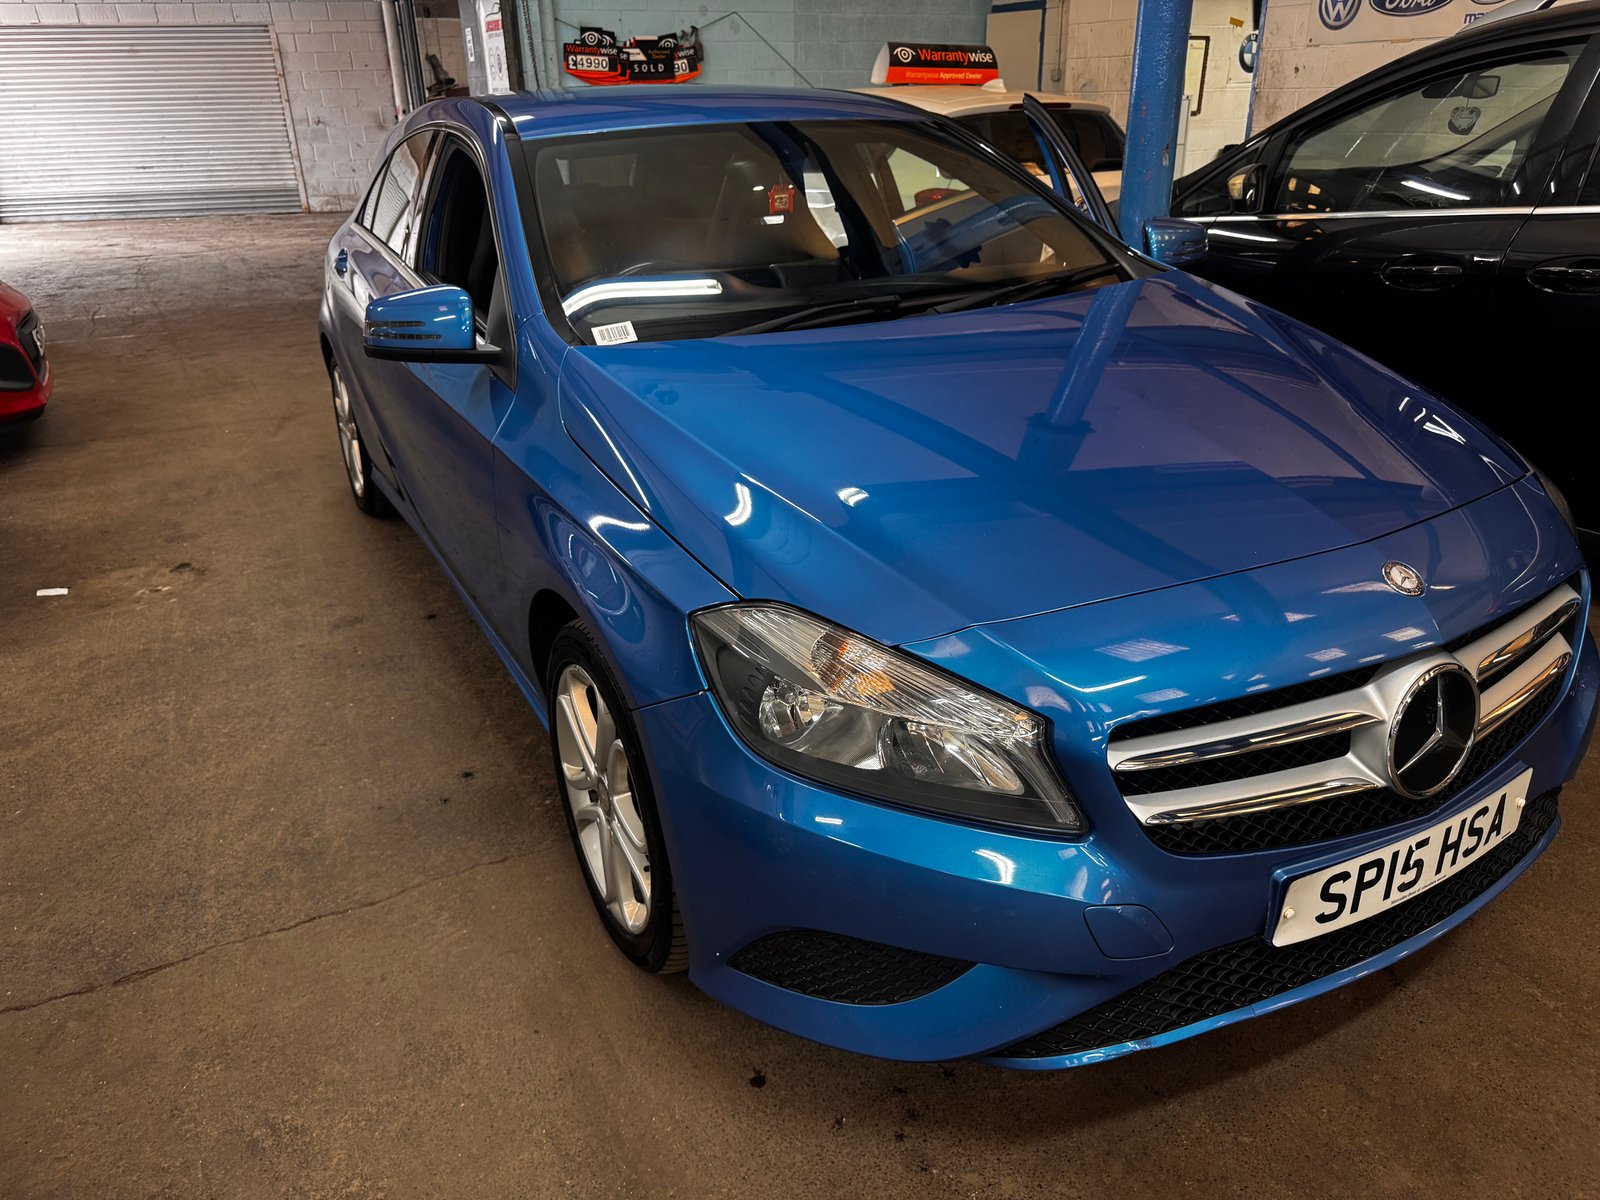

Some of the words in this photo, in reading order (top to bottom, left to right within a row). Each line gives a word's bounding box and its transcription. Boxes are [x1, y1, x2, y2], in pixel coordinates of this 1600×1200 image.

[566, 45, 618, 55] Warrantywise
[568, 55, 608, 69] £4990
[917, 48, 993, 65] Warrantywise
[634, 63, 665, 73] SOLD
[940, 71, 965, 80] Approved
[1315, 836, 1431, 924] SP15
[1435, 793, 1507, 876] HSA
